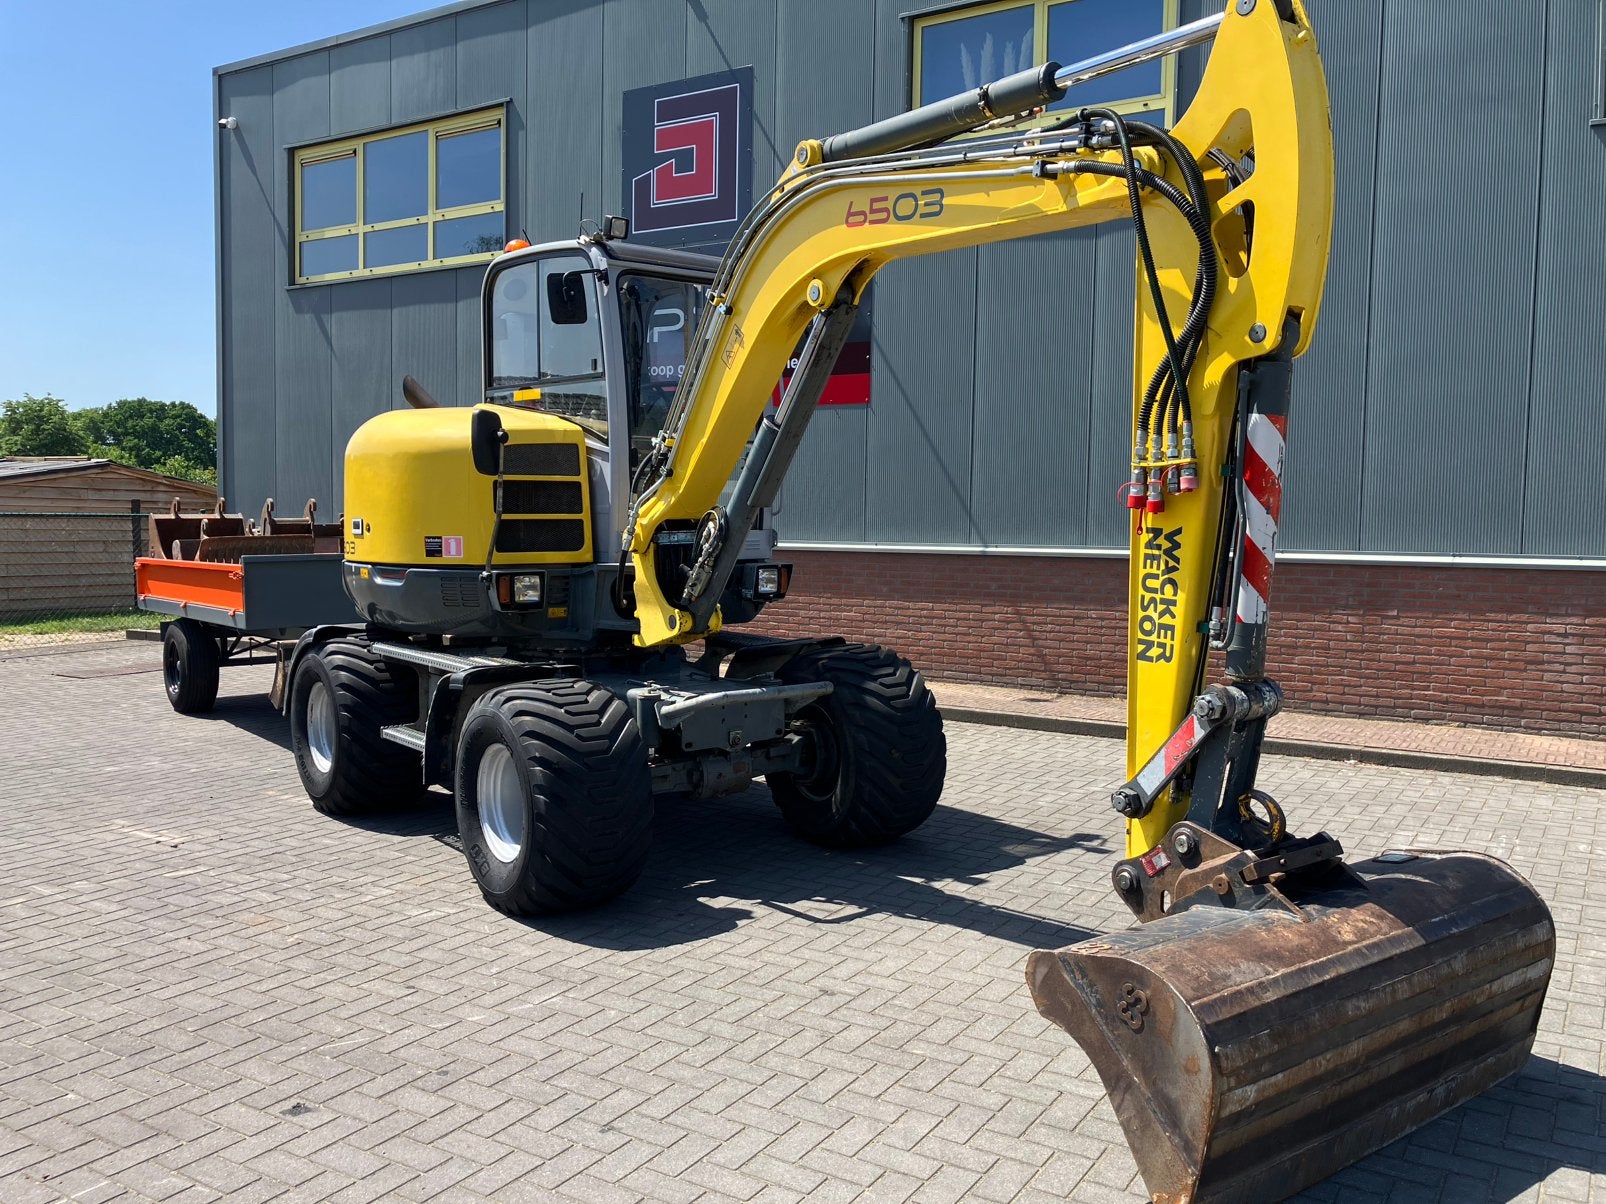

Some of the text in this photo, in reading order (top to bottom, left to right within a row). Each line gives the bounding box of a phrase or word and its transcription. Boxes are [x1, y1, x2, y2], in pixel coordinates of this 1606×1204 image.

[845, 188, 945, 228] 6503
[1136, 526, 1163, 663] NEUSON
[1155, 526, 1183, 664] WACKER
